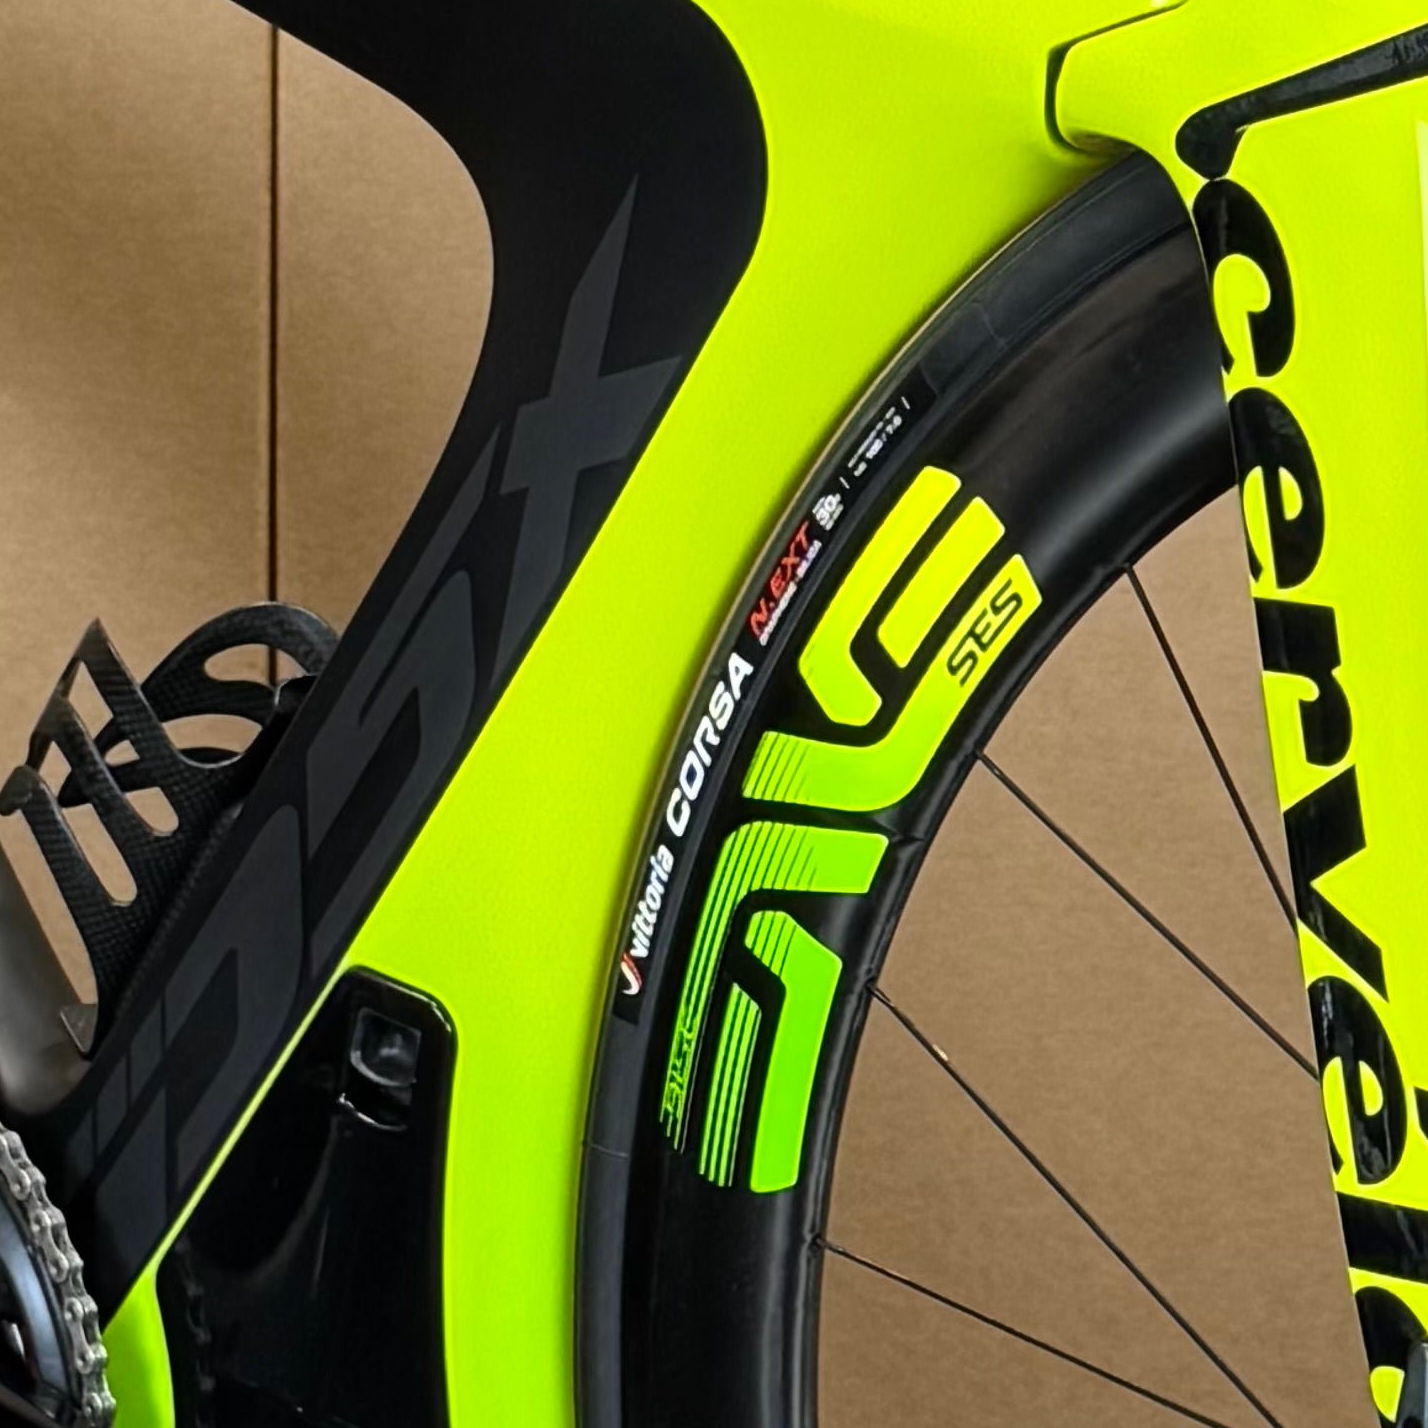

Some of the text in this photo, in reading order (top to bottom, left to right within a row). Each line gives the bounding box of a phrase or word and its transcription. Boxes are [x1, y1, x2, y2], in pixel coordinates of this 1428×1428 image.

[946, 576, 1024, 689] SES
[629, 843, 674, 959] vittoria
[666, 651, 754, 838] CORSA
